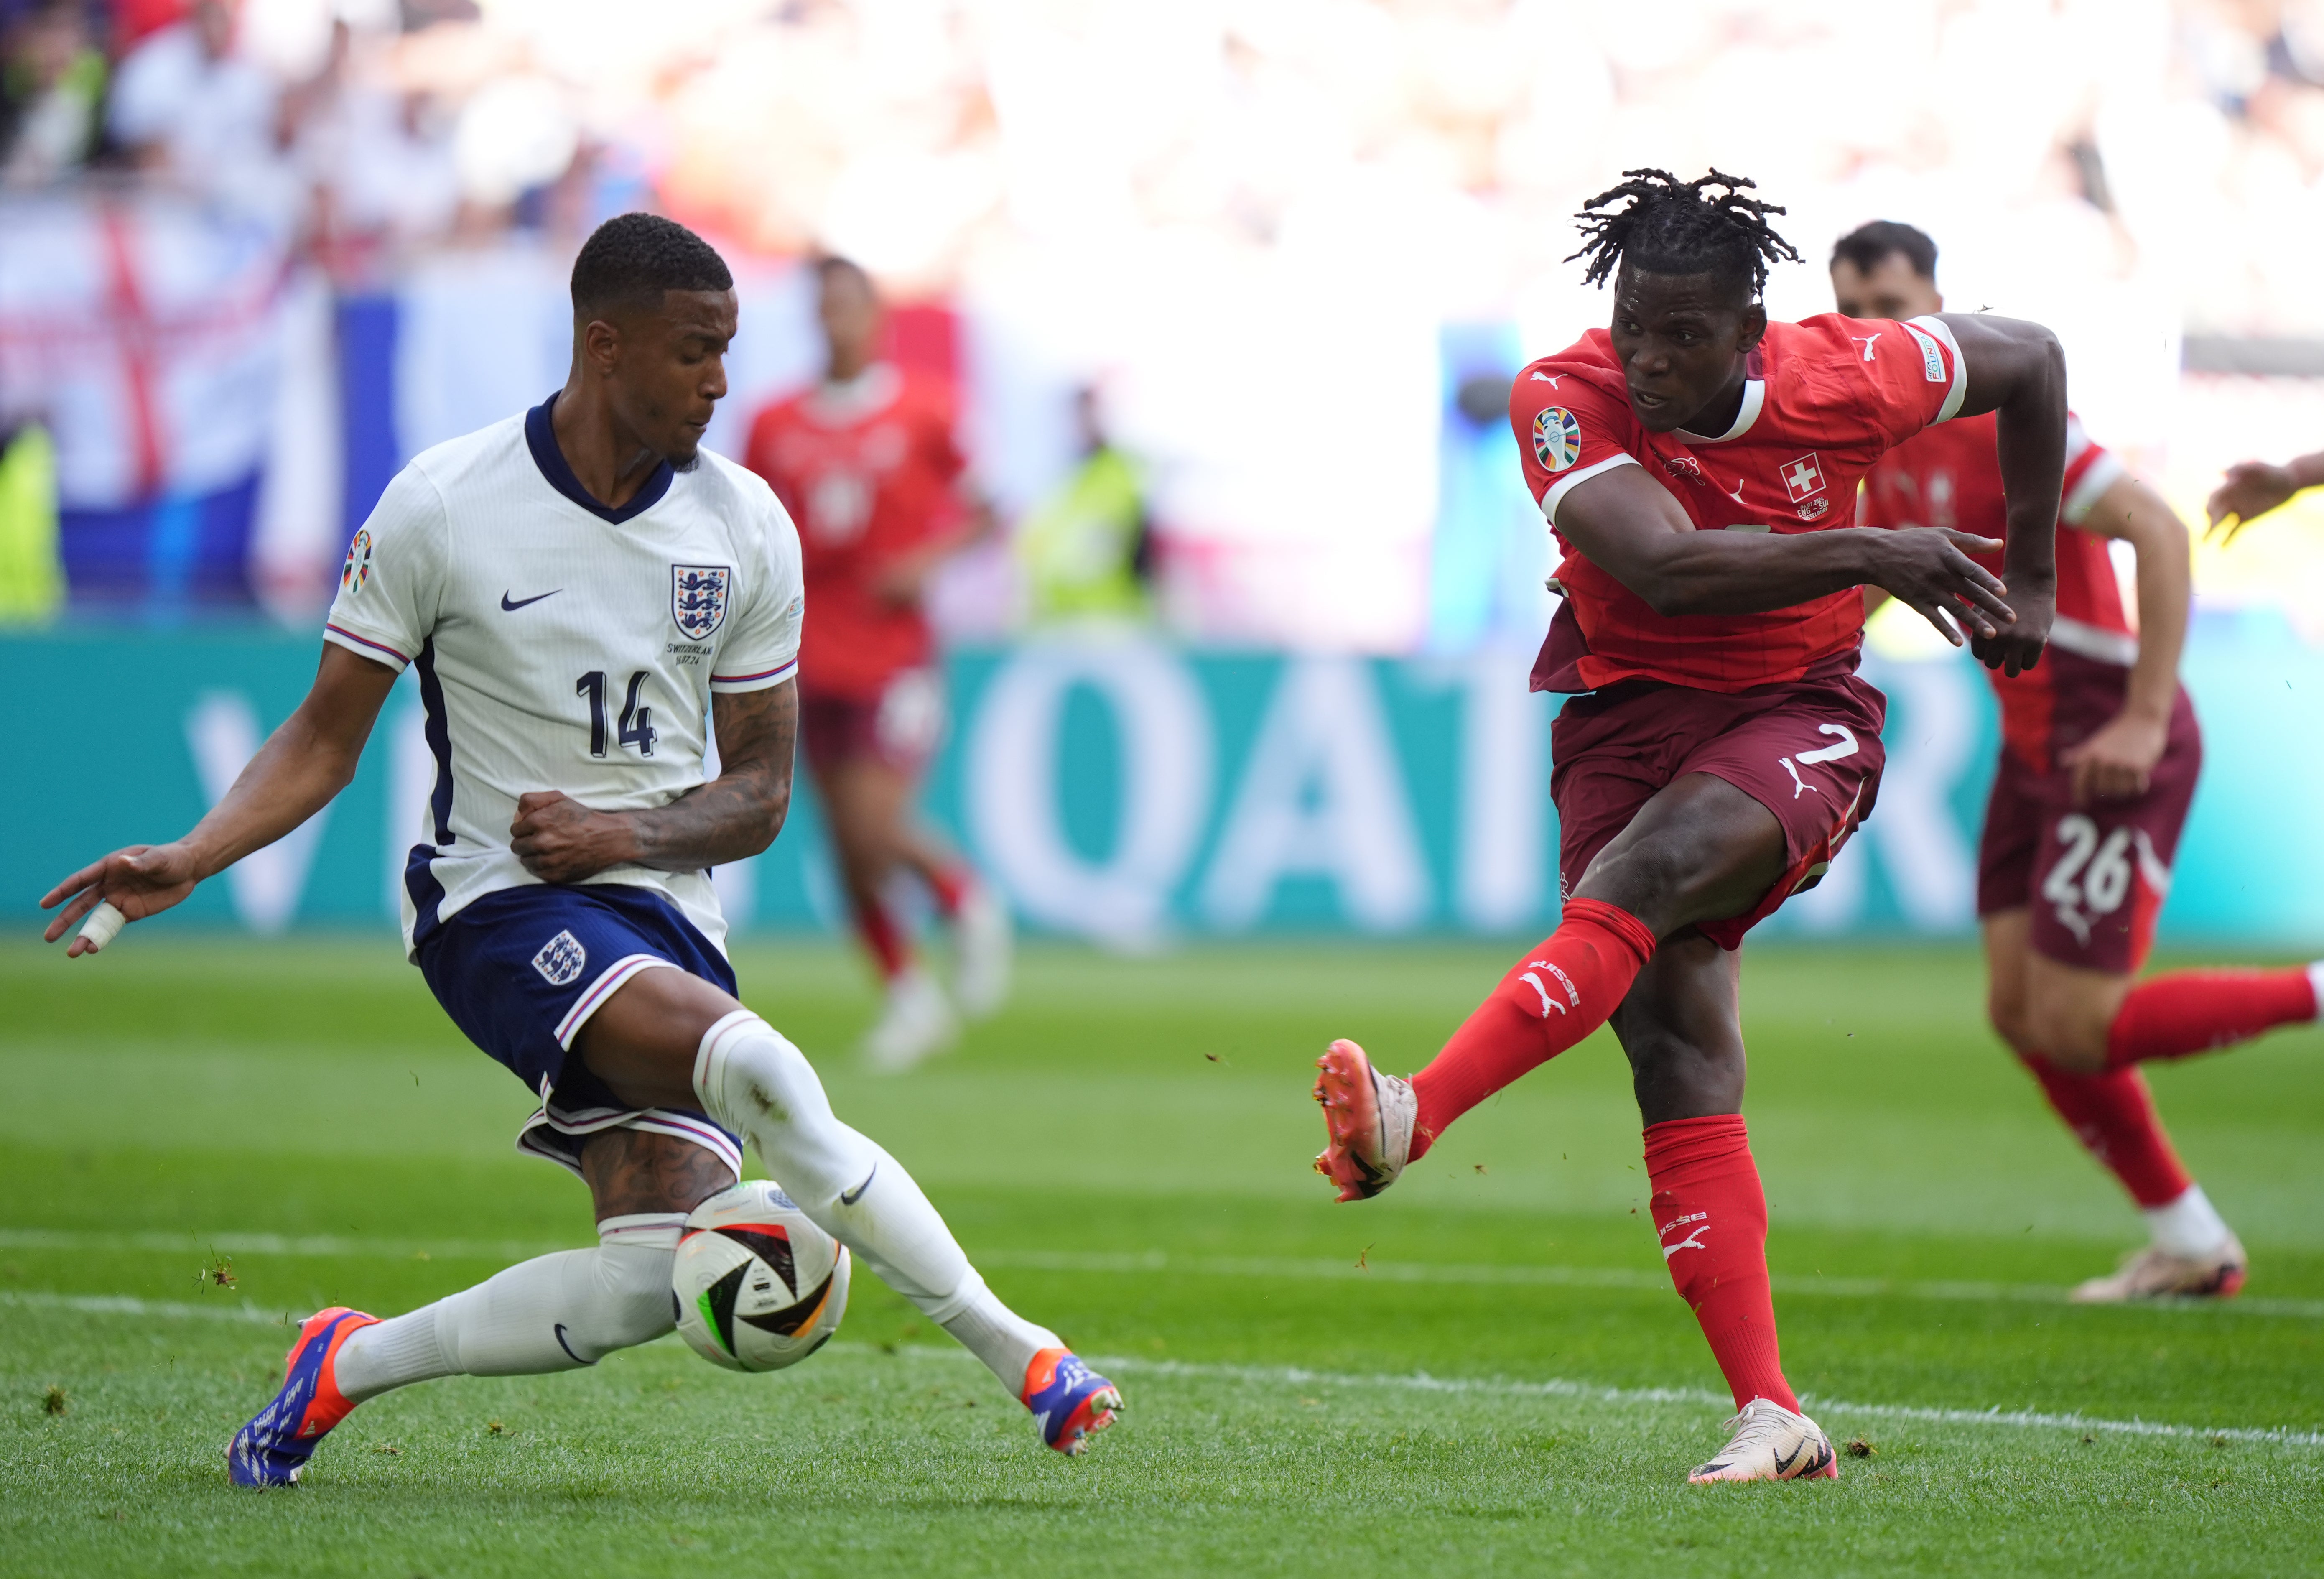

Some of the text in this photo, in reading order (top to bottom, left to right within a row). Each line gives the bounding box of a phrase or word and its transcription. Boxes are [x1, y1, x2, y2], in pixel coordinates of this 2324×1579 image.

[1797, 507, 1811, 518] ENG
[1819, 499, 1829, 510] SUI
[1800, 496, 1824, 509] 06.07.2024
[1802, 507, 1828, 521] SSELDORF
[667, 643, 713, 656] SWITZERLAN
[576, 671, 657, 758] 14
[966, 633, 1979, 945] QATR
[2041, 812, 2132, 914] 26
[1658, 1212, 1708, 1242] UISSE
